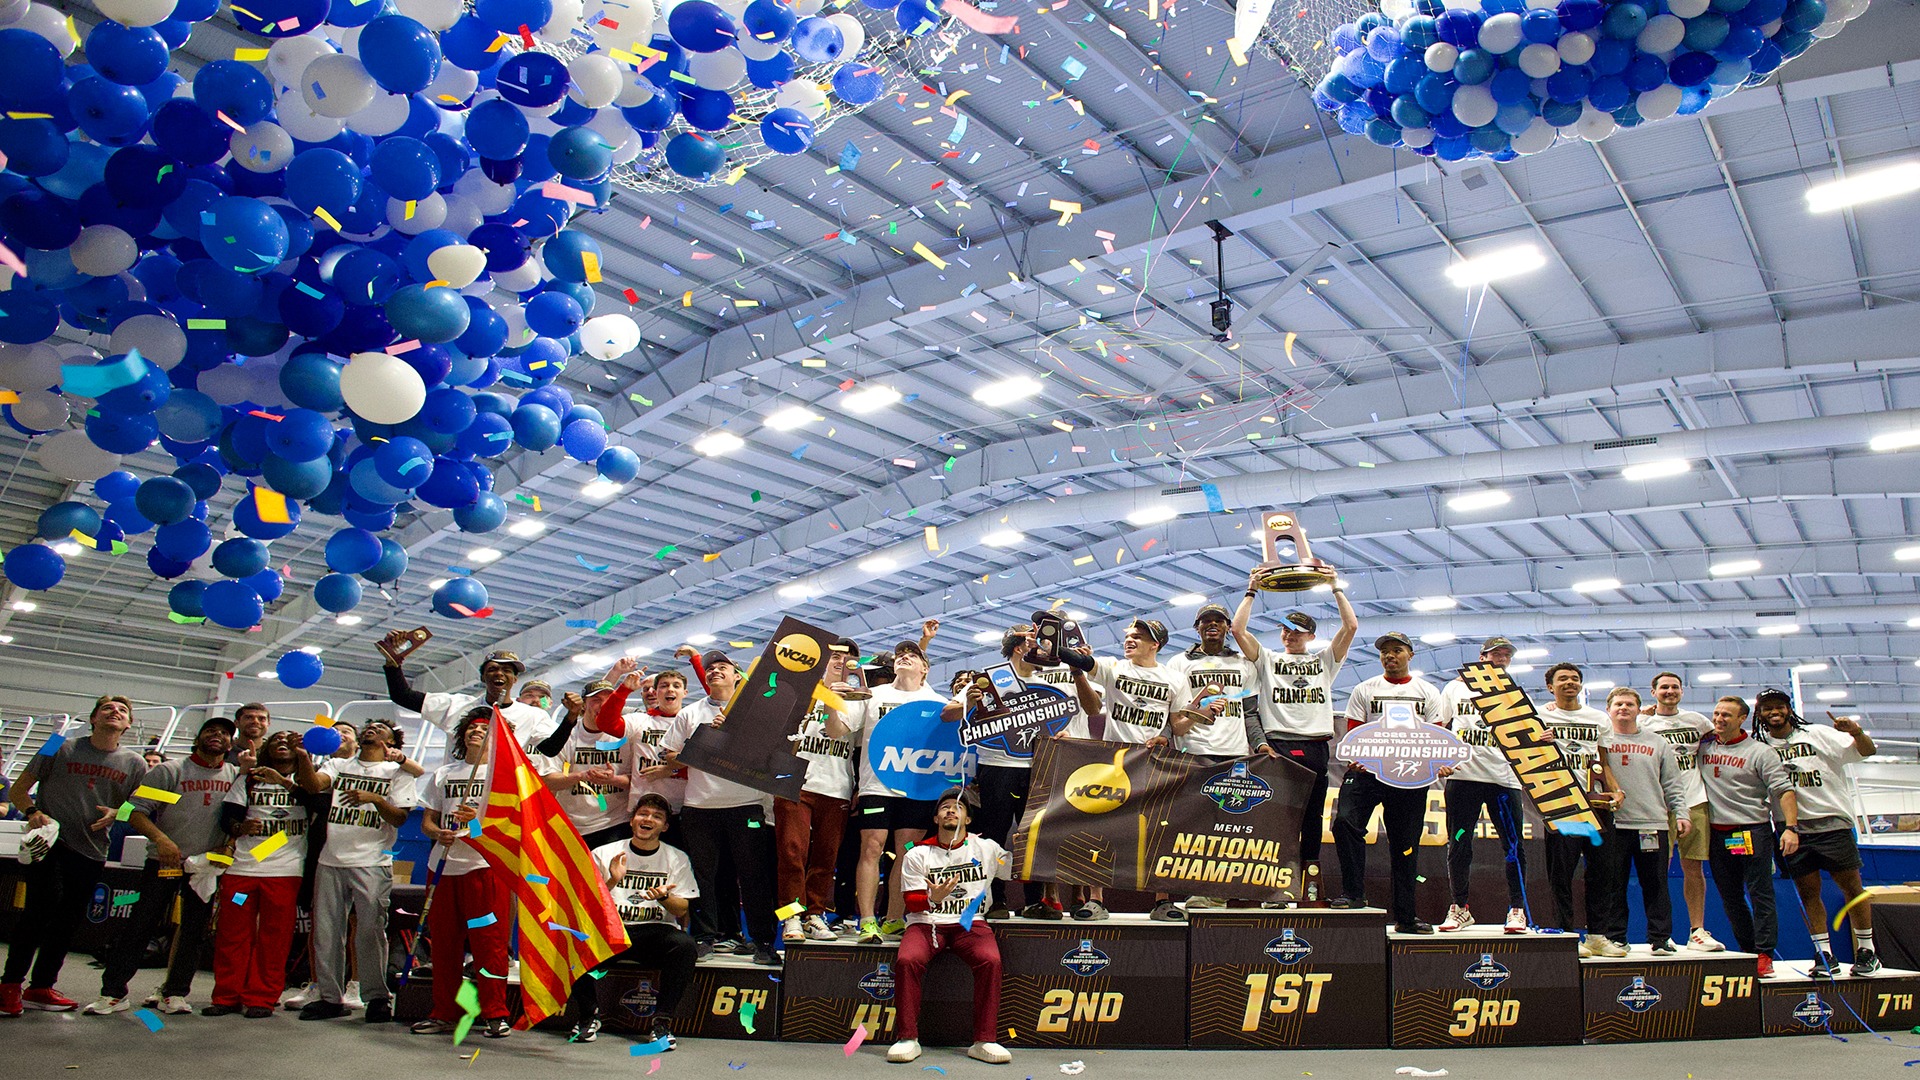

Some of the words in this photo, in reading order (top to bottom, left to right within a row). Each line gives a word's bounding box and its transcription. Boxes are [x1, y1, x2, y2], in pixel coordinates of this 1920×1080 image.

[778, 646, 817, 668] NCAA
[995, 674, 1015, 686] NCAA
[1115, 679, 1169, 701] NATIONAL
[1036, 696, 1057, 707] FIELD
[962, 700, 1077, 743] CHAMPIONSHIPS
[878, 745, 977, 778] NCAA
[1340, 745, 1468, 759] CHAMPIONSHIPS
[66, 762, 128, 785] TRADITION
[180, 779, 233, 793] TRADITIO
[1068, 783, 1126, 803] NCAA
[1203, 785, 1272, 798] CHAMPIONSHIPS
[1214, 823, 1255, 834] MEN'S
[1172, 832, 1281, 864] NATIONAL
[1154, 856, 1293, 889] CHAMPIONS
[711, 985, 769, 1016] 6TH
[1241, 973, 1333, 1031] 1ST
[1700, 975, 1754, 1007] 5TH
[1036, 988, 1124, 1032] 2ND
[1448, 997, 1520, 1037] 3RD
[1877, 993, 1913, 1018] 7TH
